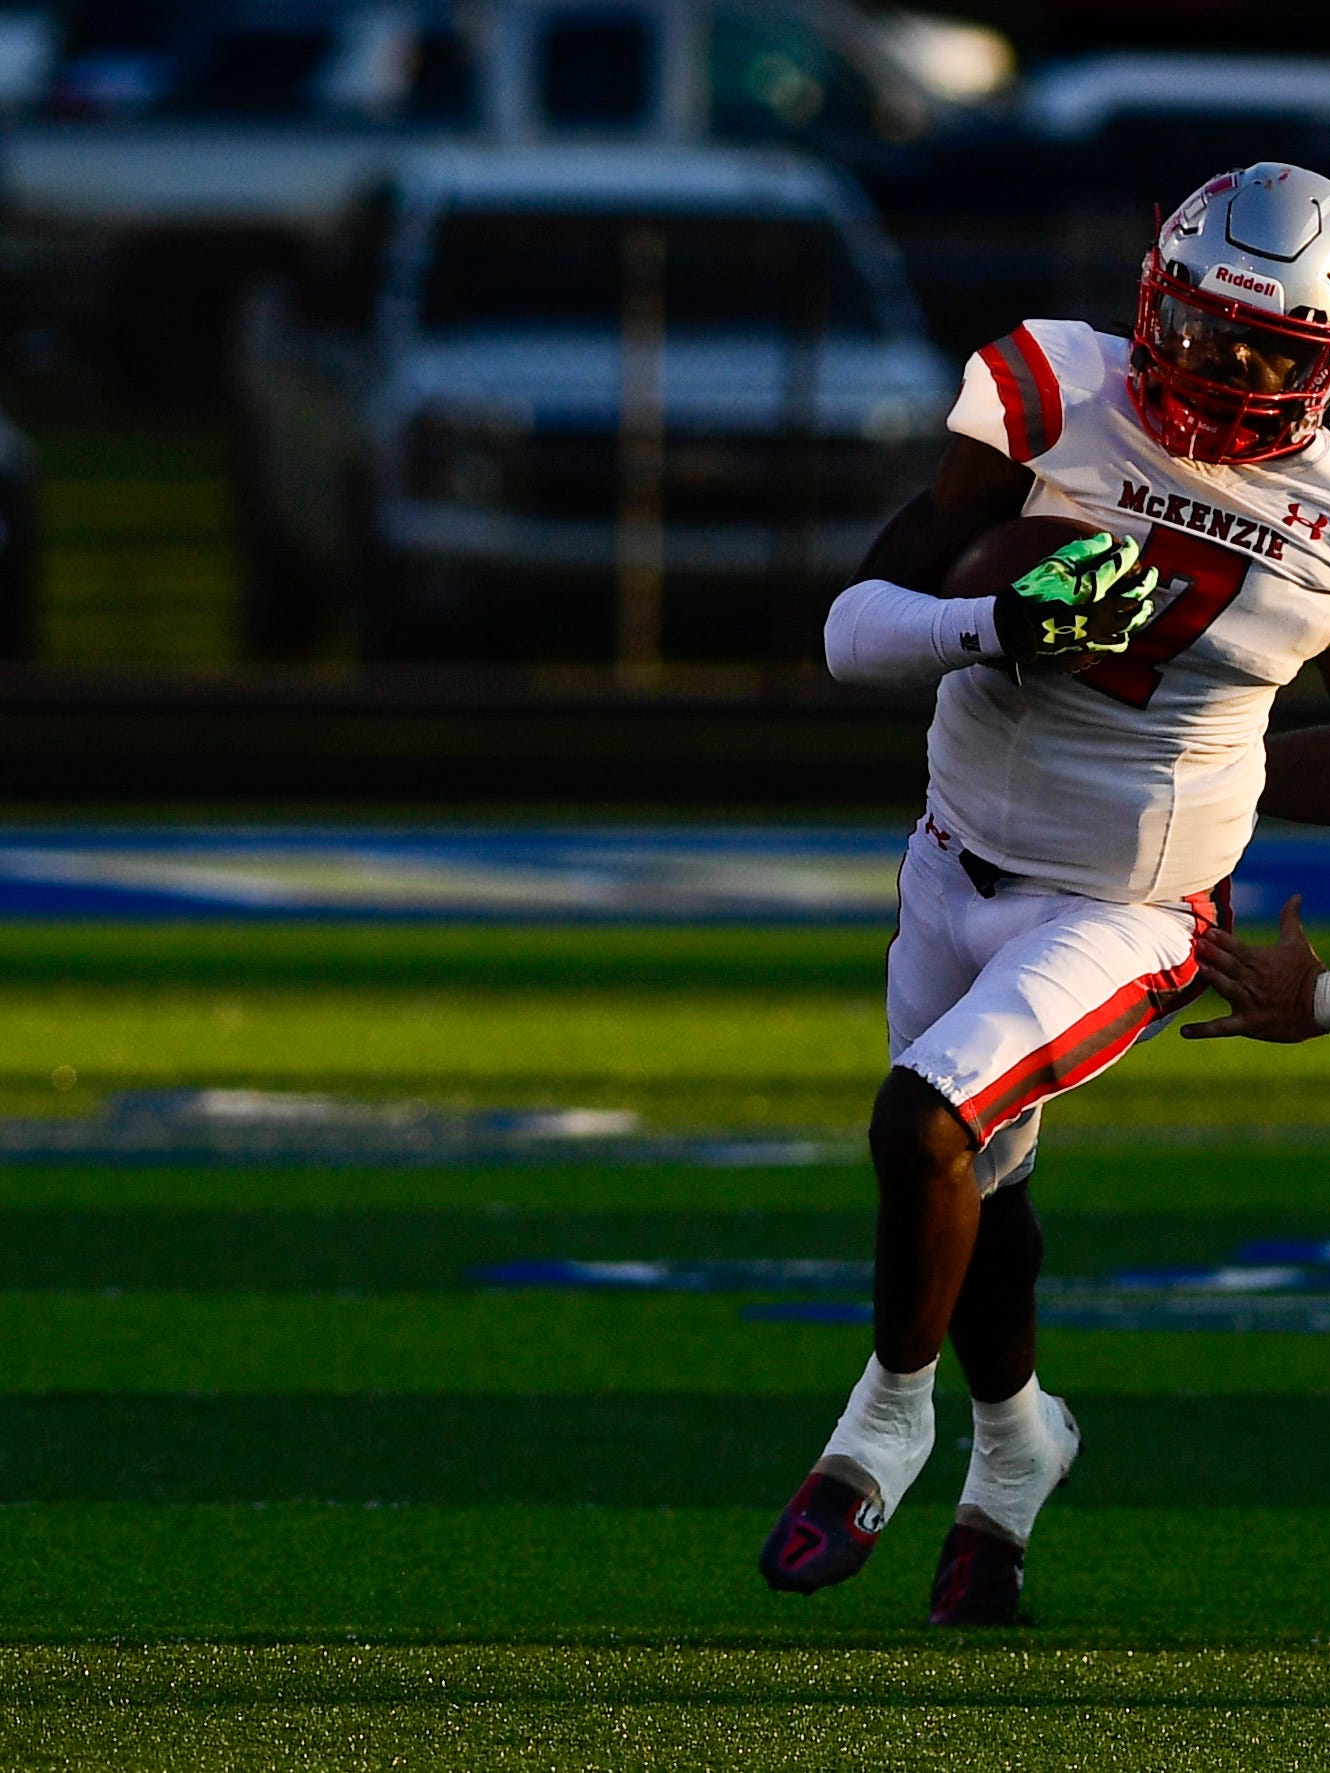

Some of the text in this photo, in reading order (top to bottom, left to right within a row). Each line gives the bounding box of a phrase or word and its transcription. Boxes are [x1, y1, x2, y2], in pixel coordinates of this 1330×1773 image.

[1216, 266, 1275, 297] Riddell
[1117, 480, 1289, 561] McKENZIE
[1073, 522, 1253, 711] 7
